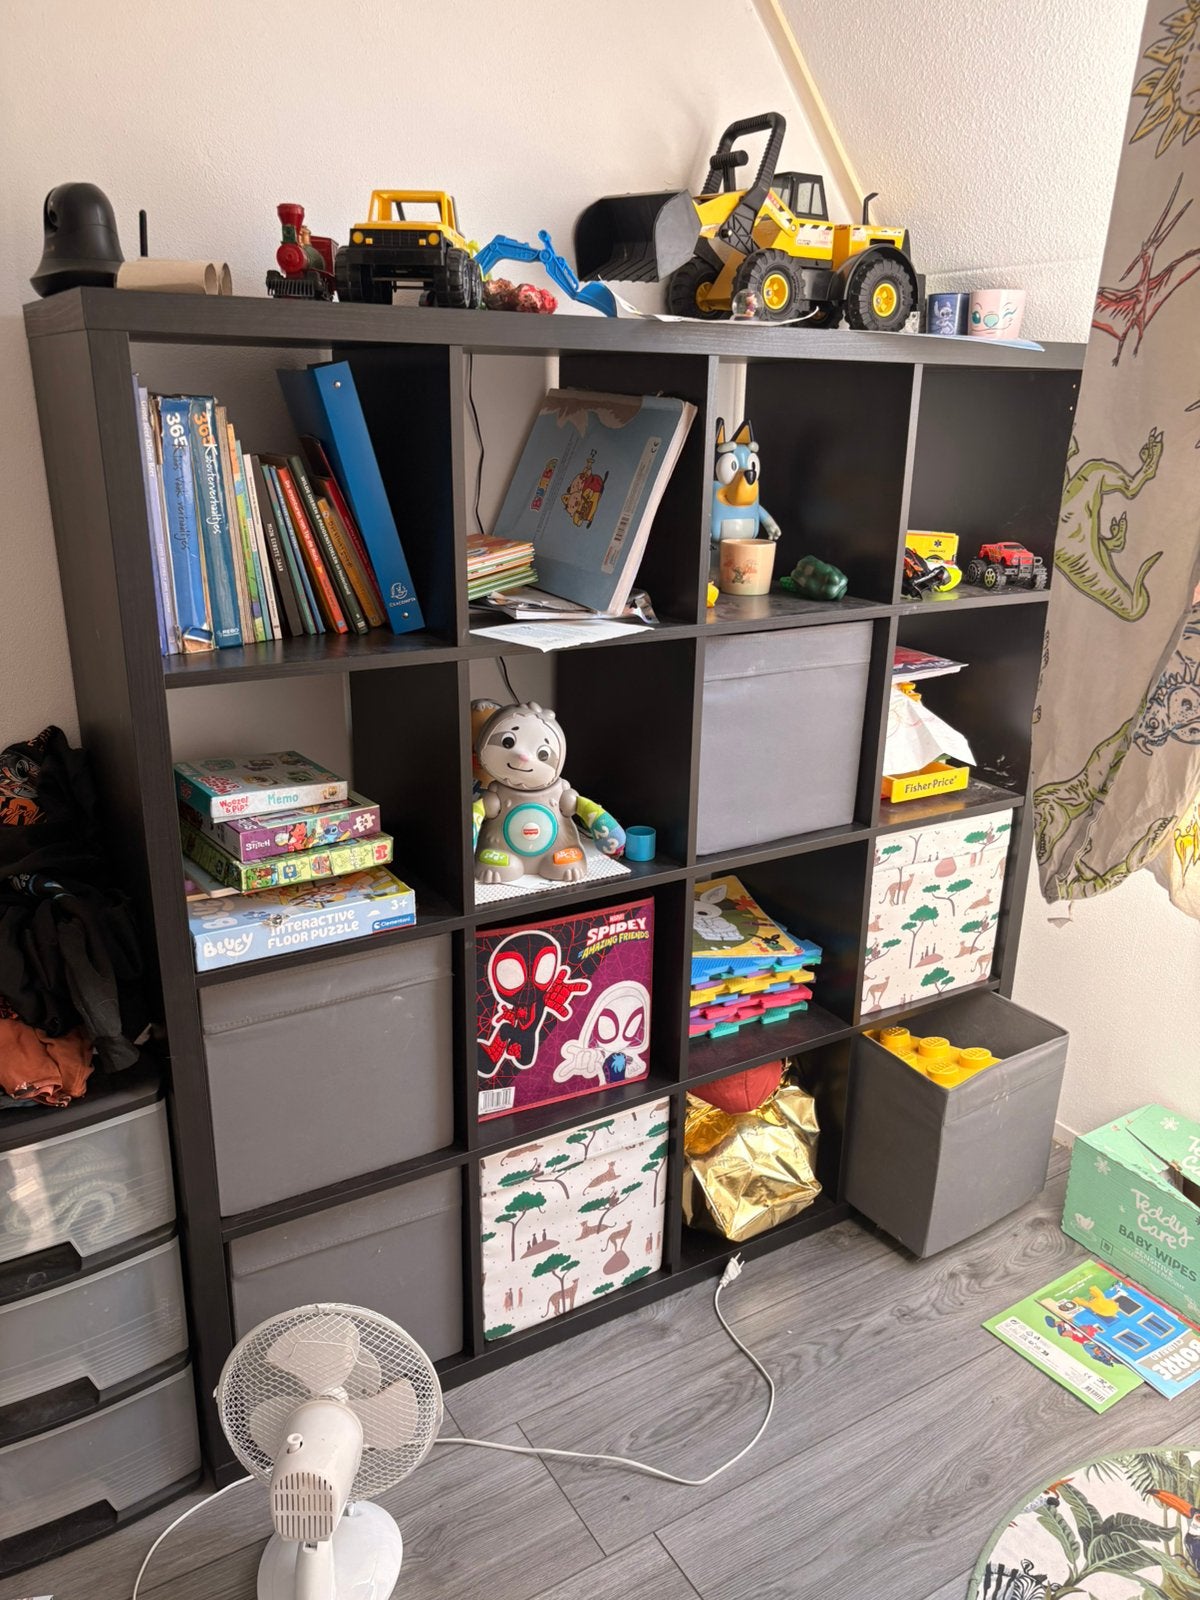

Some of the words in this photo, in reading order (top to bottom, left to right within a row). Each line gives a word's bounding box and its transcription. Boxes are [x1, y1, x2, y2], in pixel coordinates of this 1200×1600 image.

[166, 412, 188, 448] 365
[285, 480, 290, 488] De
[301, 476, 310, 494] WILDE
[308, 493, 318, 514] DIEREN
[318, 518, 338, 564] PADDENSTOELEN
[219, 796, 249, 808] Woezel
[268, 791, 299, 805] Memo
[391, 899, 408, 910] 3+
[267, 927, 309, 949] FLOOR
[581, 935, 618, 960] AMAZING
[618, 931, 650, 944] FRIENDS
[587, 917, 647, 946] SPIDEY
[1130, 1188, 1195, 1248] Teddy
[1137, 1213, 1177, 1250] Care
[1118, 1224, 1153, 1250] BABY
[1156, 1246, 1198, 1282] WIPES
